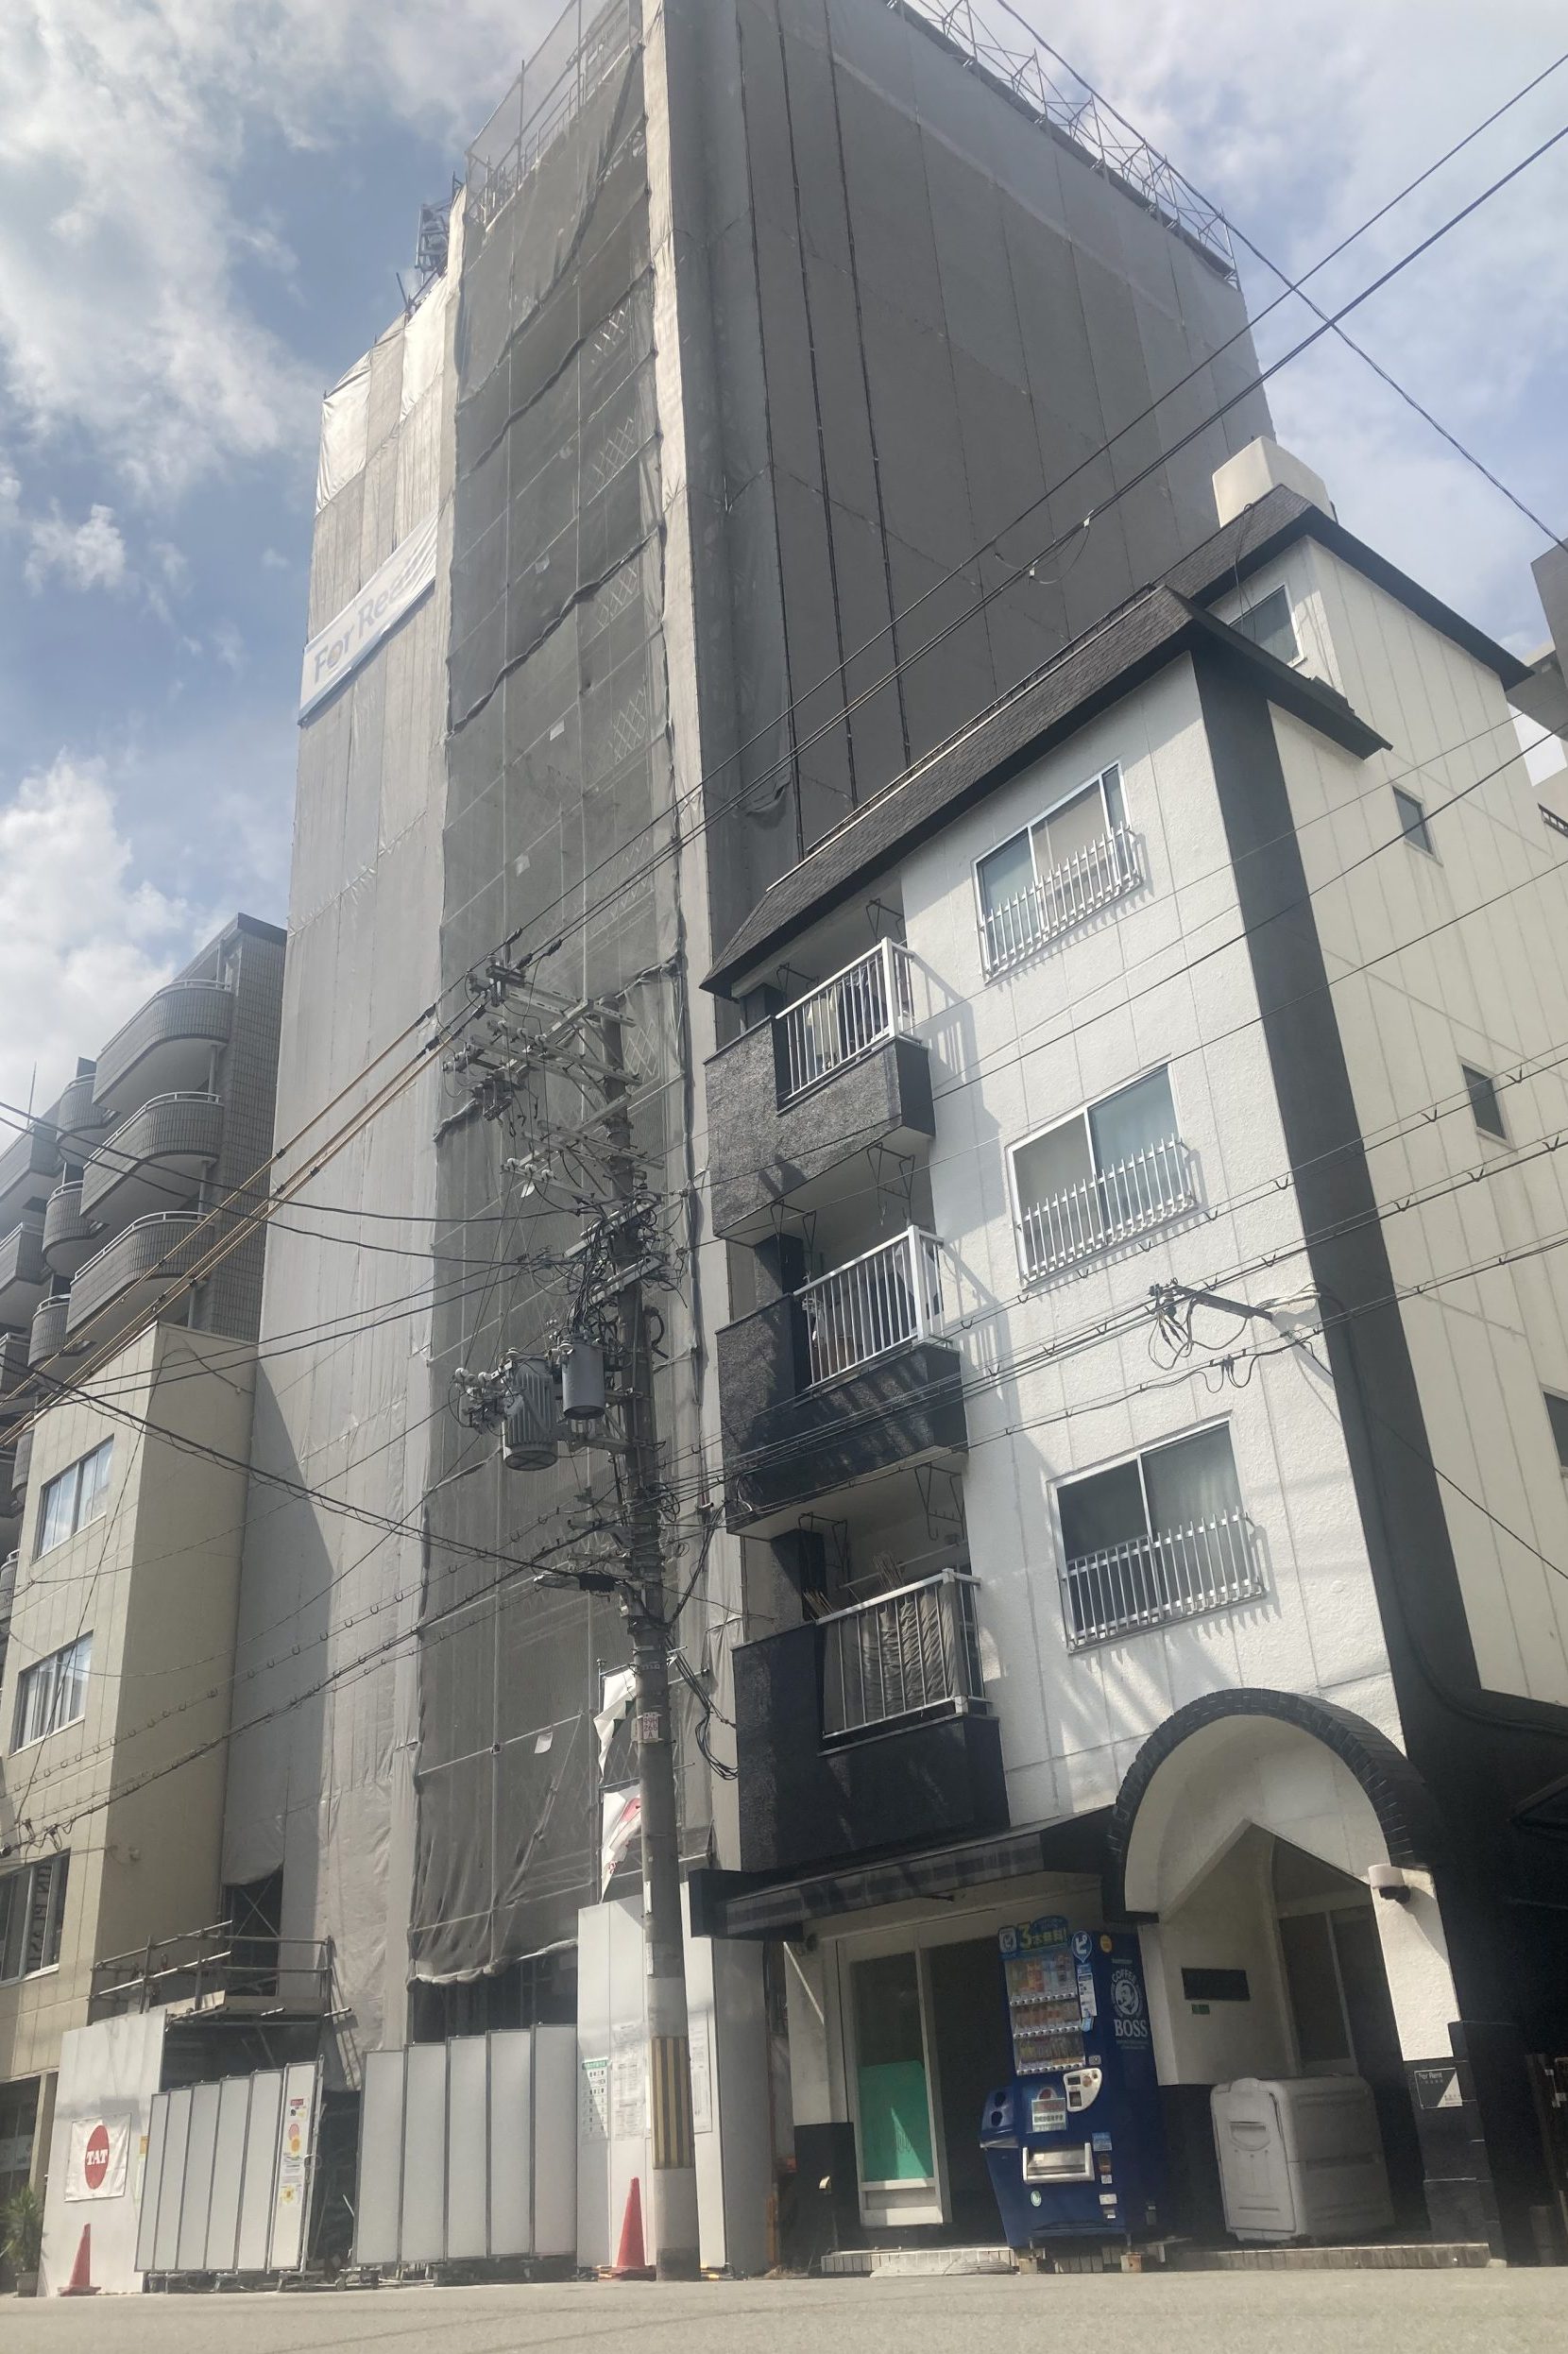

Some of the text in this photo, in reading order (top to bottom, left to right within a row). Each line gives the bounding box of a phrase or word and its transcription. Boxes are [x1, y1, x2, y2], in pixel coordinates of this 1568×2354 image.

[314, 624, 357, 684] For
[1112, 1969, 1137, 1984] COFFEE
[1114, 2019, 1148, 2038] BOSS
[86, 2149, 109, 2166] TAT
